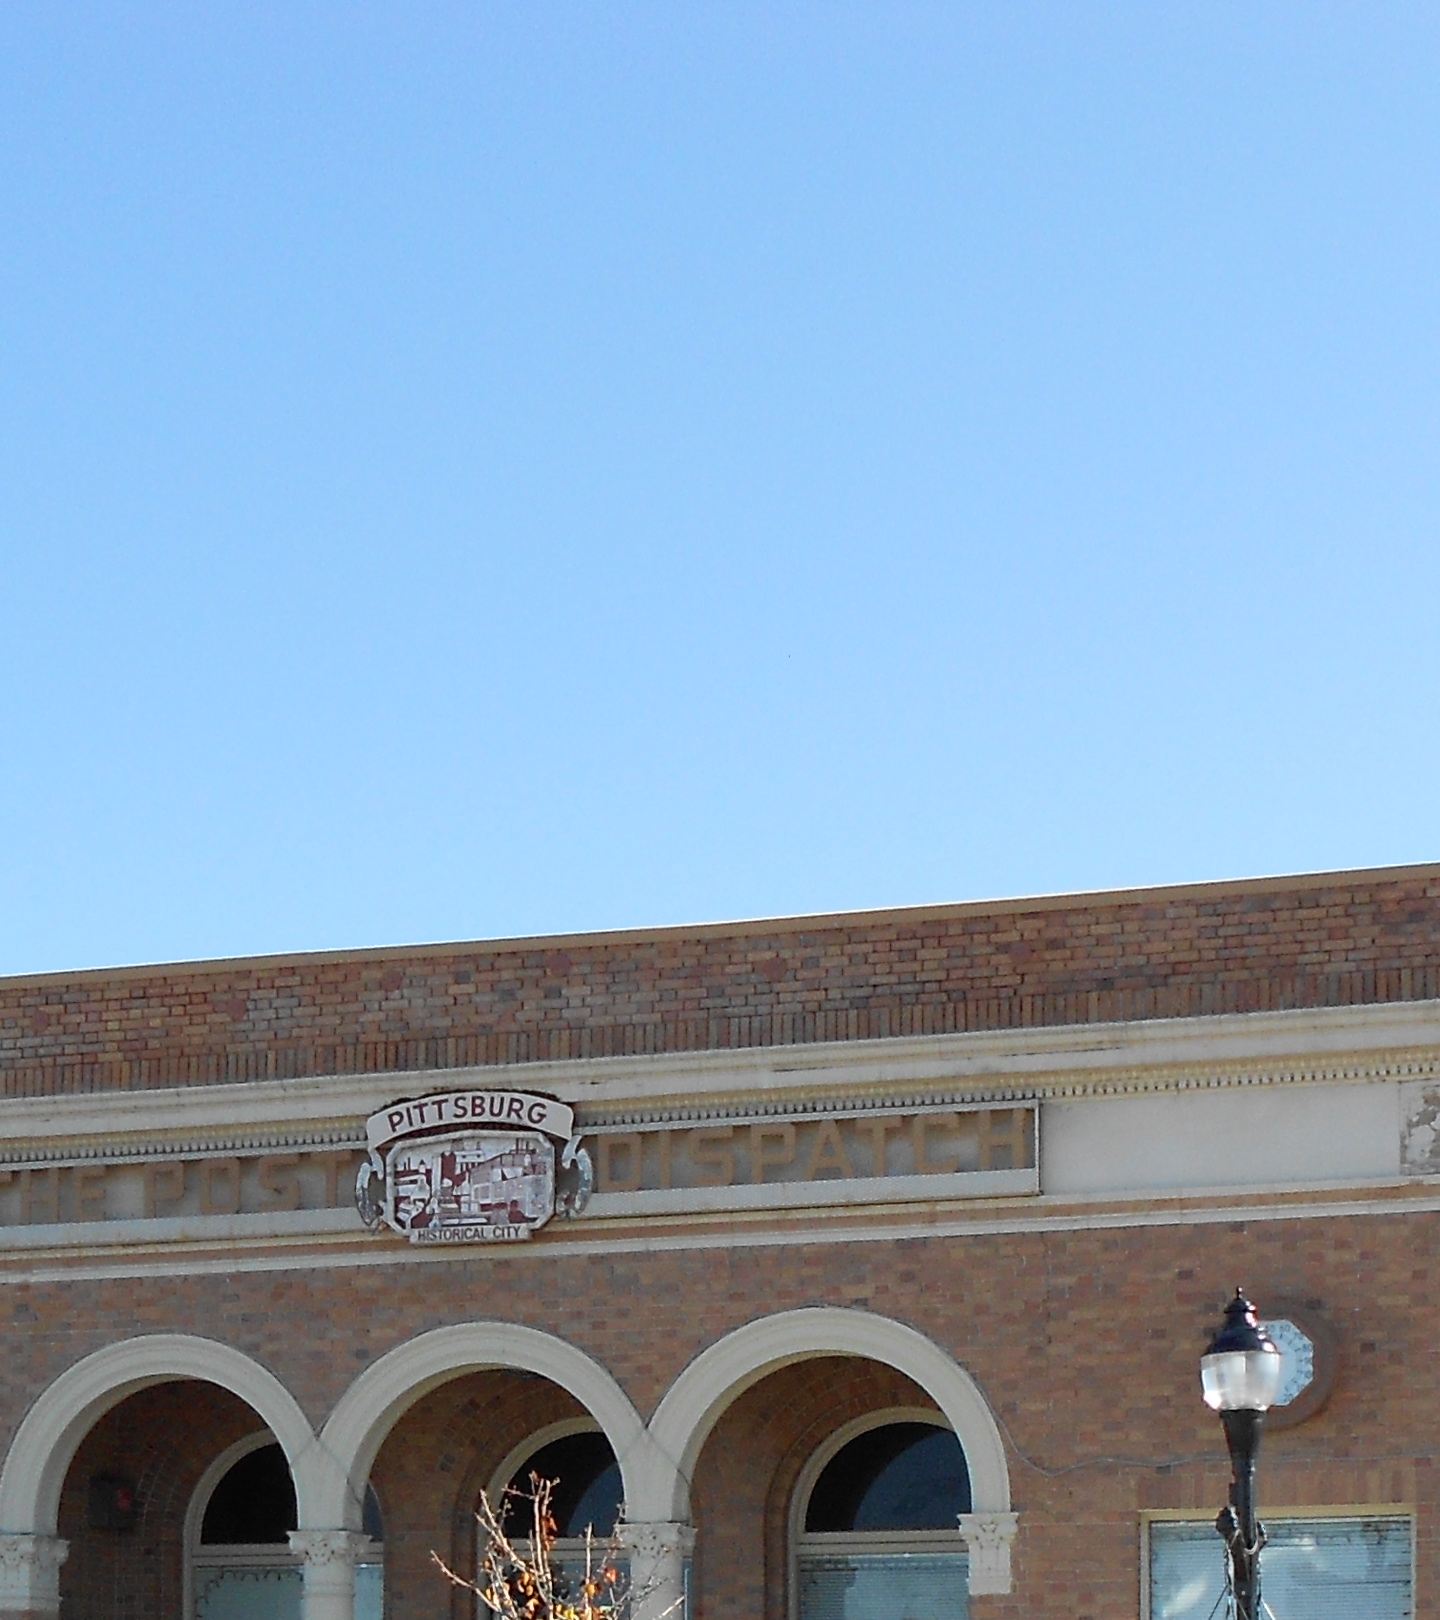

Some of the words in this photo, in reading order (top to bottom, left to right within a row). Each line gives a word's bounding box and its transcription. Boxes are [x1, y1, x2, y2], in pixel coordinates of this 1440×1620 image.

[388, 1095, 547, 1133] PITTSBURG
[143, 1151, 353, 1218] POST
[597, 1109, 1027, 1192] DISPATCH
[417, 1227, 487, 1241] HISTORICAL
[492, 1226, 522, 1239] CITY
